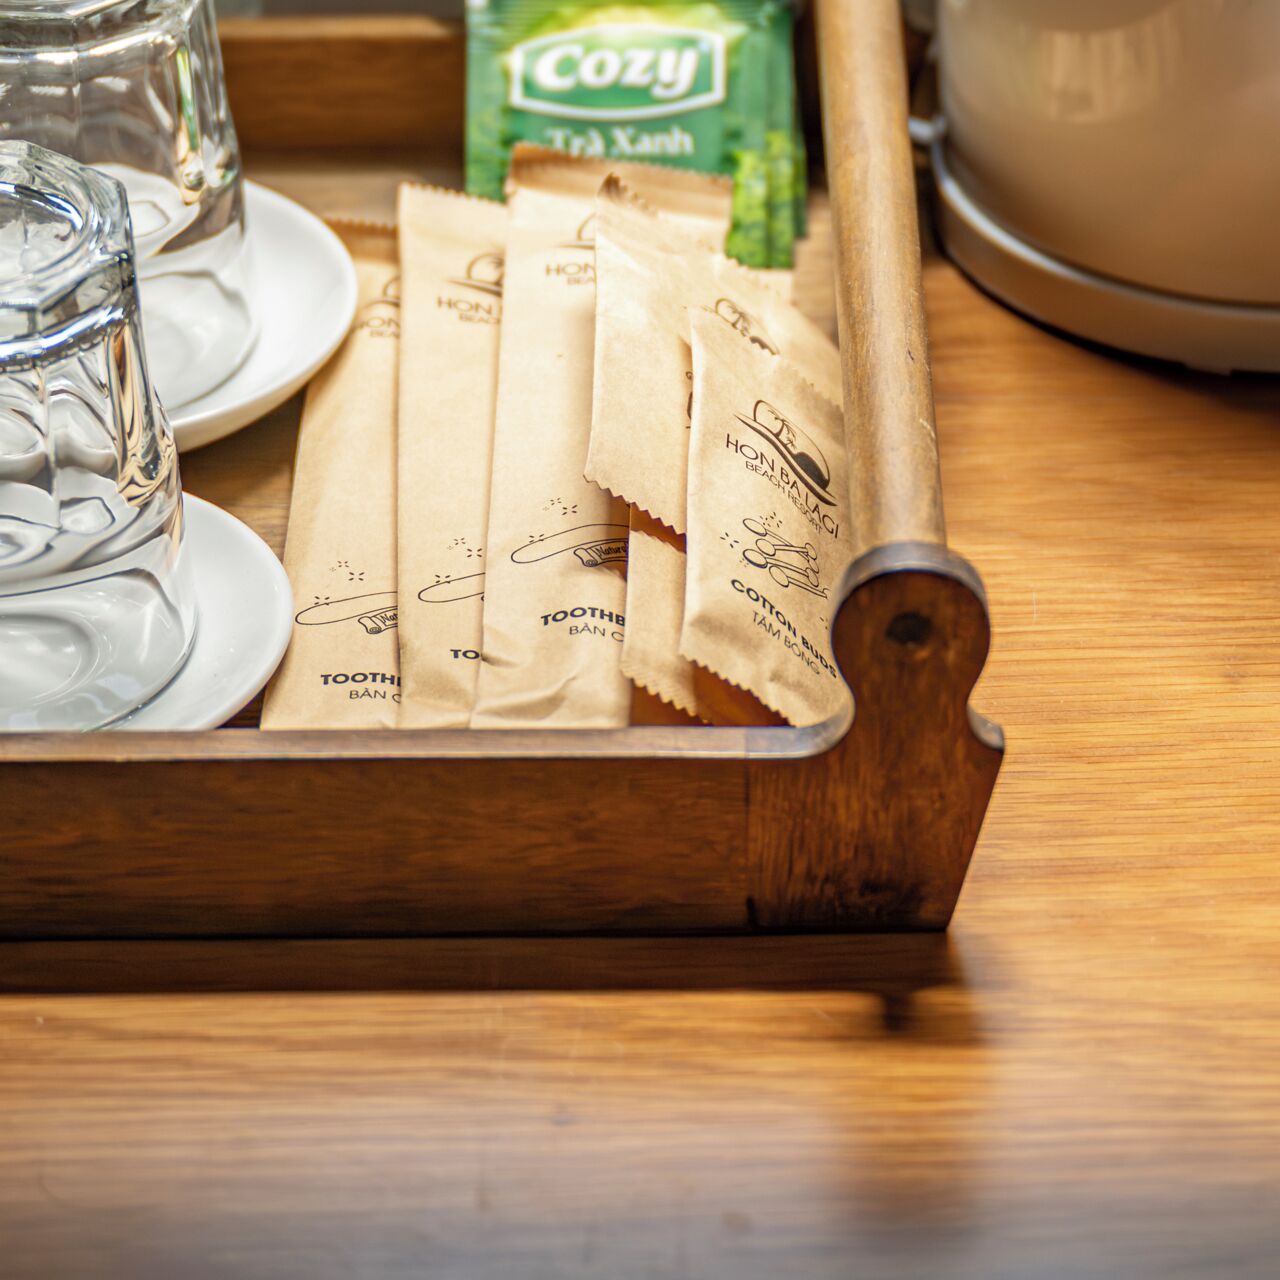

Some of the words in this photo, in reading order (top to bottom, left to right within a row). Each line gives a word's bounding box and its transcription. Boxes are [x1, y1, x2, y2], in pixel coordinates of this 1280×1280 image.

[534, 43, 700, 99] Cozy
[611, 123, 695, 157] Xanh
[437, 295, 492, 315] HON
[725, 433, 775, 473] HON
[780, 466, 801, 499] BA
[805, 491, 839, 539] LAGI
[745, 460, 786, 494] BEACH
[730, 578, 797, 639] COTTON
[801, 635, 837, 679] BUDS
